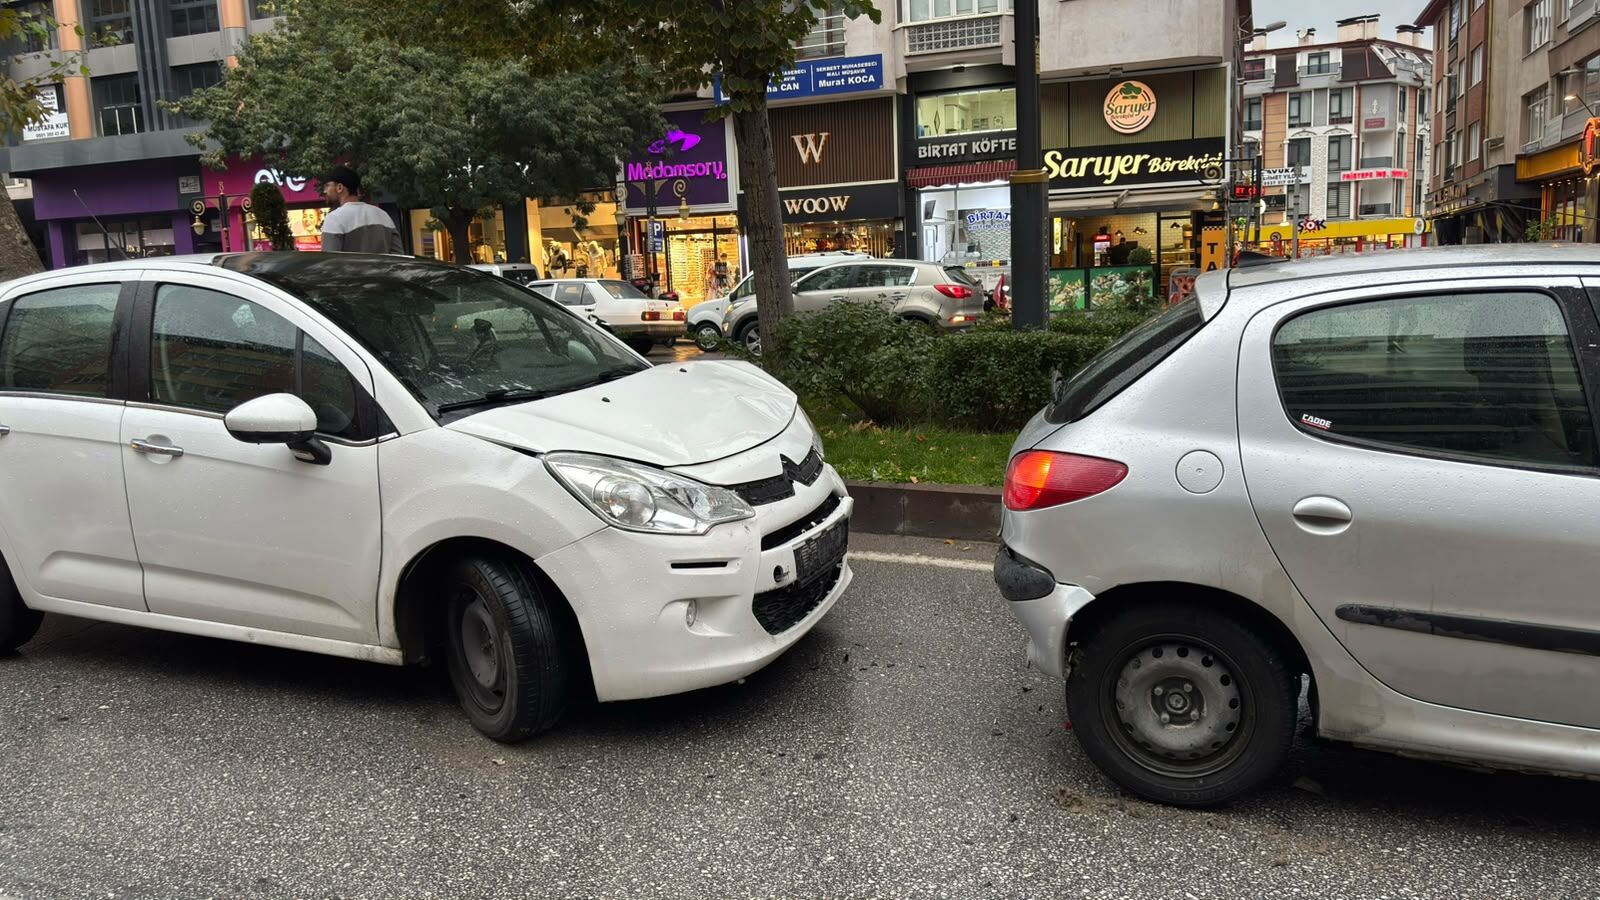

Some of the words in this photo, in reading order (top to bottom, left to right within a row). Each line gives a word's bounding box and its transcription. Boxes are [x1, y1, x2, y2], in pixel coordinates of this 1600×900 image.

[816, 65, 840, 73] SERBEST
[780, 83, 800, 92] CAN
[818, 78, 845, 88] Murat
[848, 75, 876, 85] KOCA
[791, 131, 830, 165] W
[918, 143, 967, 159] BİRTAT
[971, 137, 1017, 154] KÖFTE
[1042, 150, 1151, 185] Sarıyer
[784, 195, 851, 215] WOOW
[967, 210, 1011, 225] BİRTAT
[653, 222, 661, 236] P
[1302, 414, 1332, 428] CADDE
